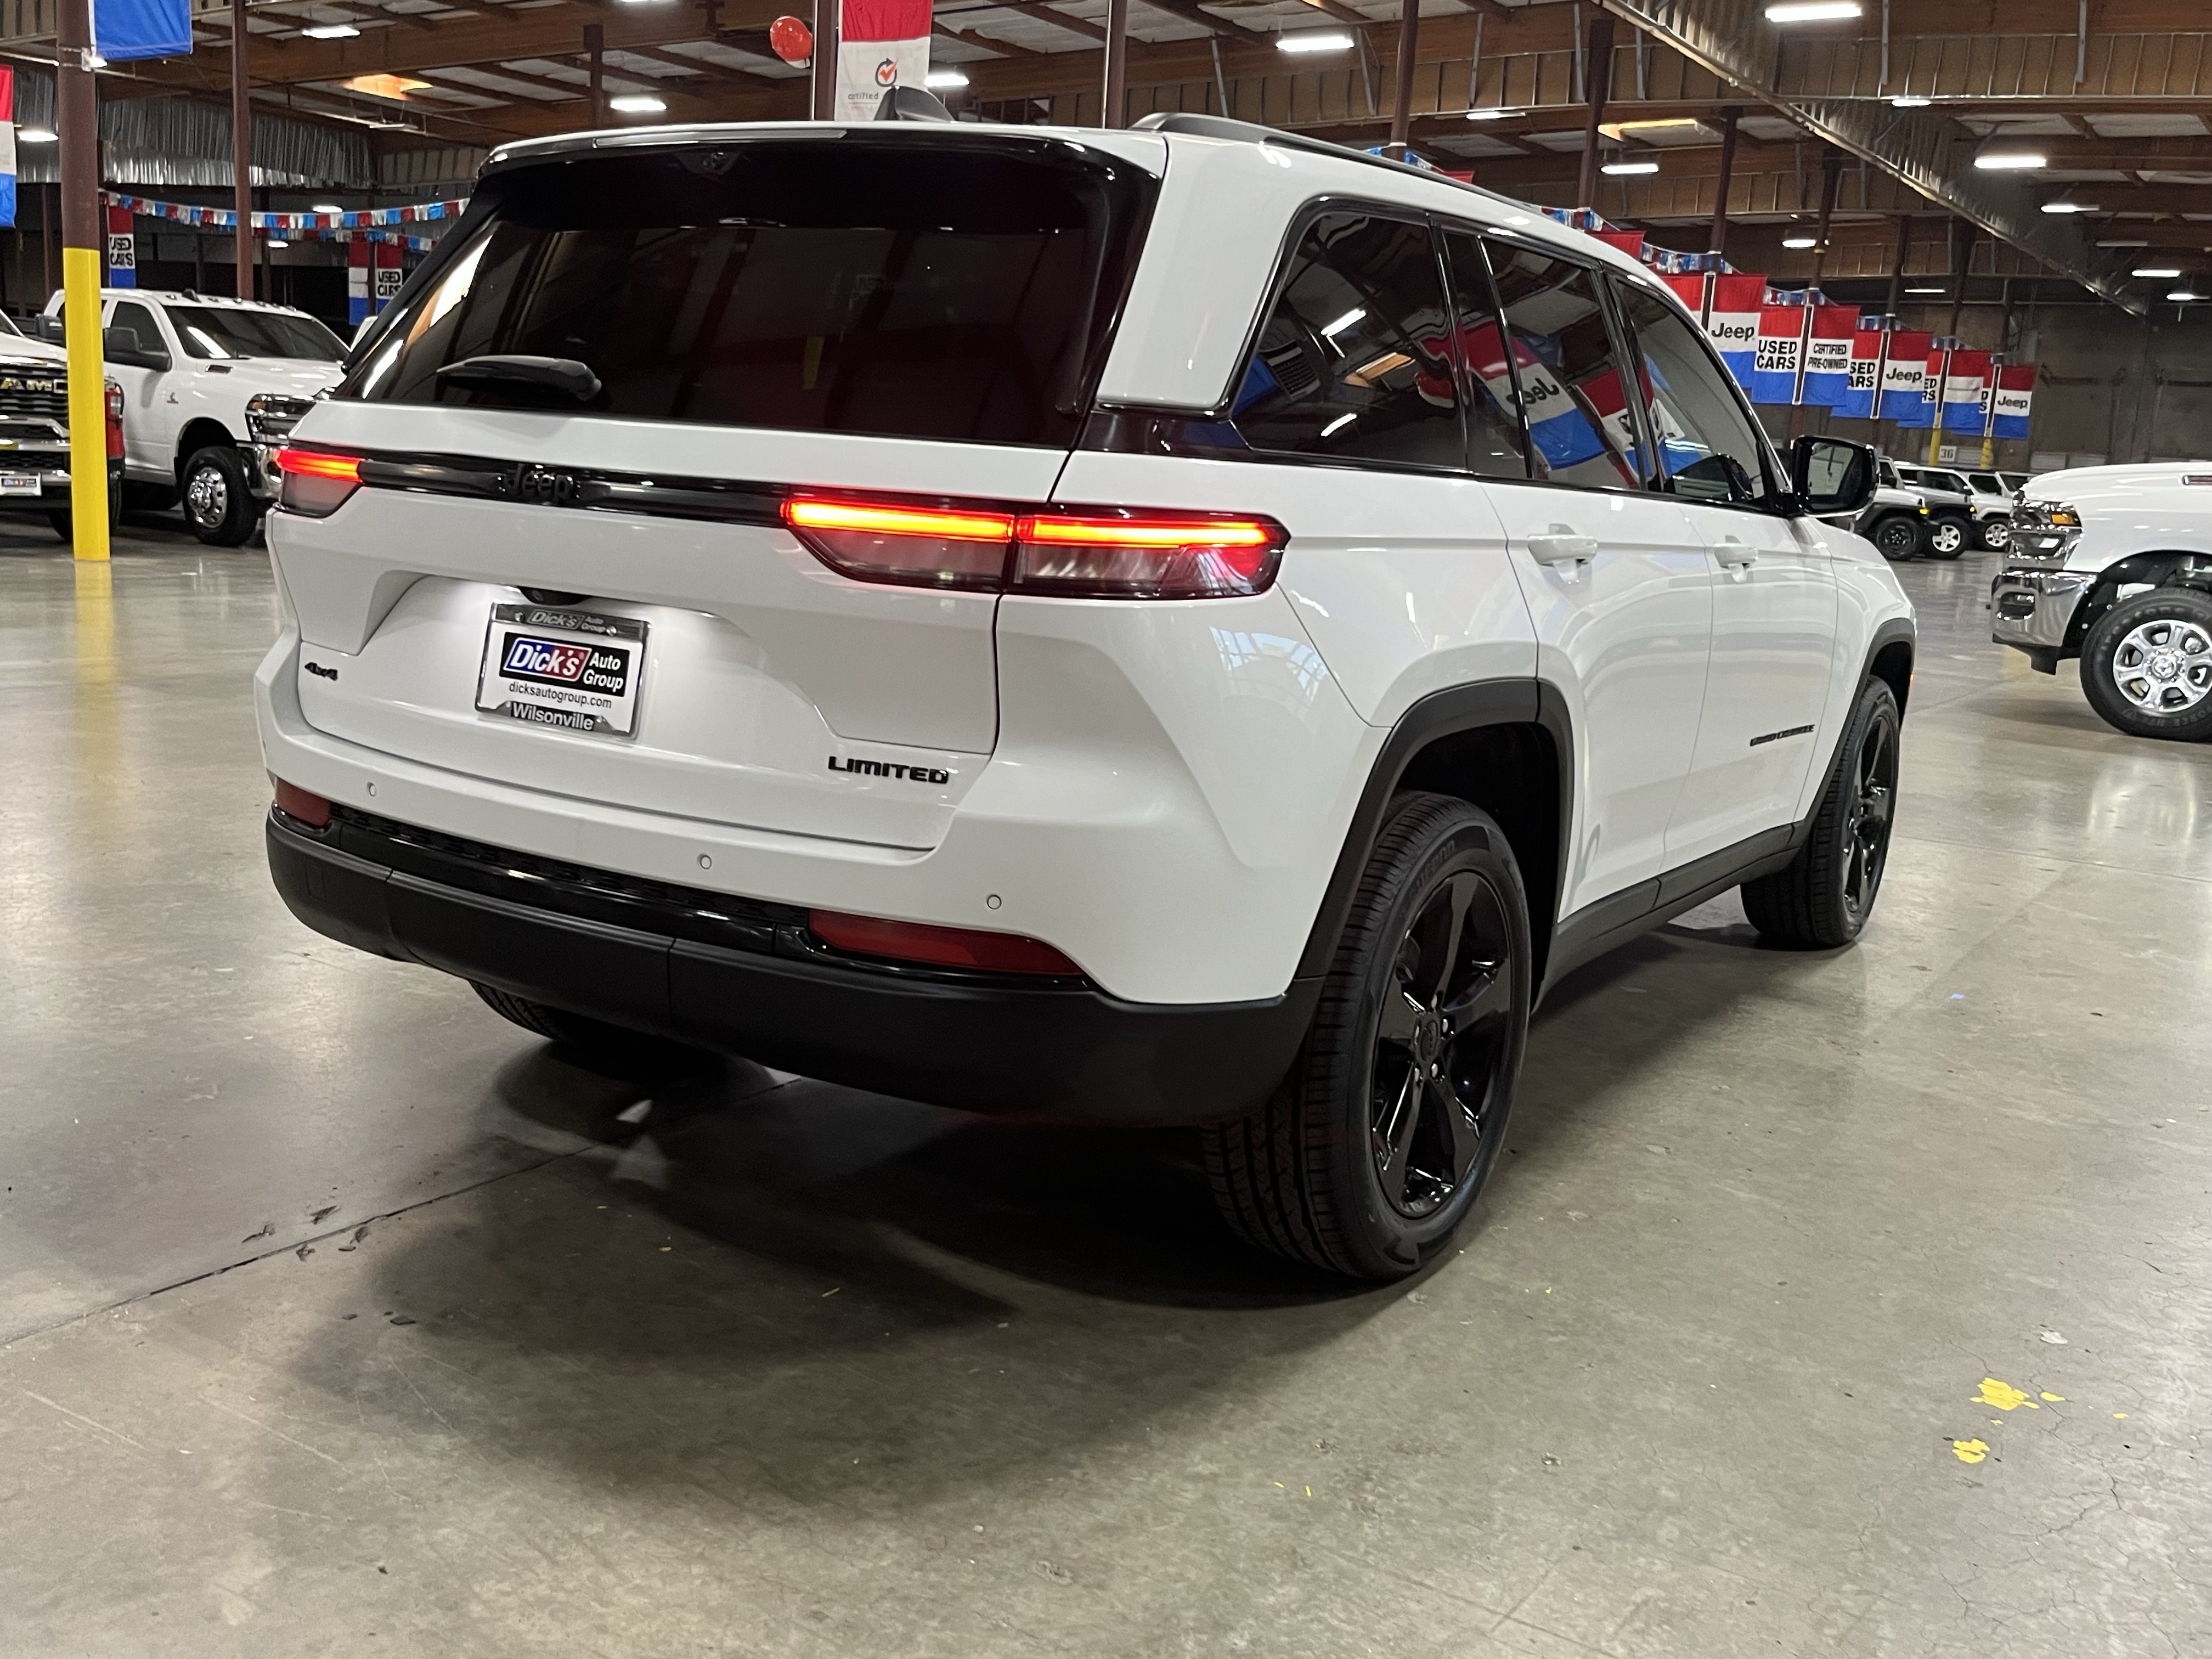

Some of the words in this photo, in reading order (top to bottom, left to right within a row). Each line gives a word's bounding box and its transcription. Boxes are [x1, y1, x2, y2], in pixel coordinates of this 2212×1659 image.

[110, 236, 132, 251] USED
[378, 271, 400, 284] USED
[1711, 323, 1754, 342] Jeep
[1758, 340, 1797, 354] USED
[1757, 355, 1796, 369] CARS
[1808, 357, 1848, 369] PRE-OWNED
[1849, 362, 1876, 374] SED
[1848, 375, 1874, 387] ARS
[1886, 368, 1922, 383] Jeep
[1997, 396, 2028, 409] Jeep
[1940, 449, 1954, 459] 36
[510, 644, 580, 676] Dick's
[589, 652, 621, 670] Auto
[583, 669, 624, 692] Group
[509, 681, 612, 709] dicksautogroup.com
[512, 702, 594, 730] Wilsonville
[828, 755, 949, 784] LIMITED
